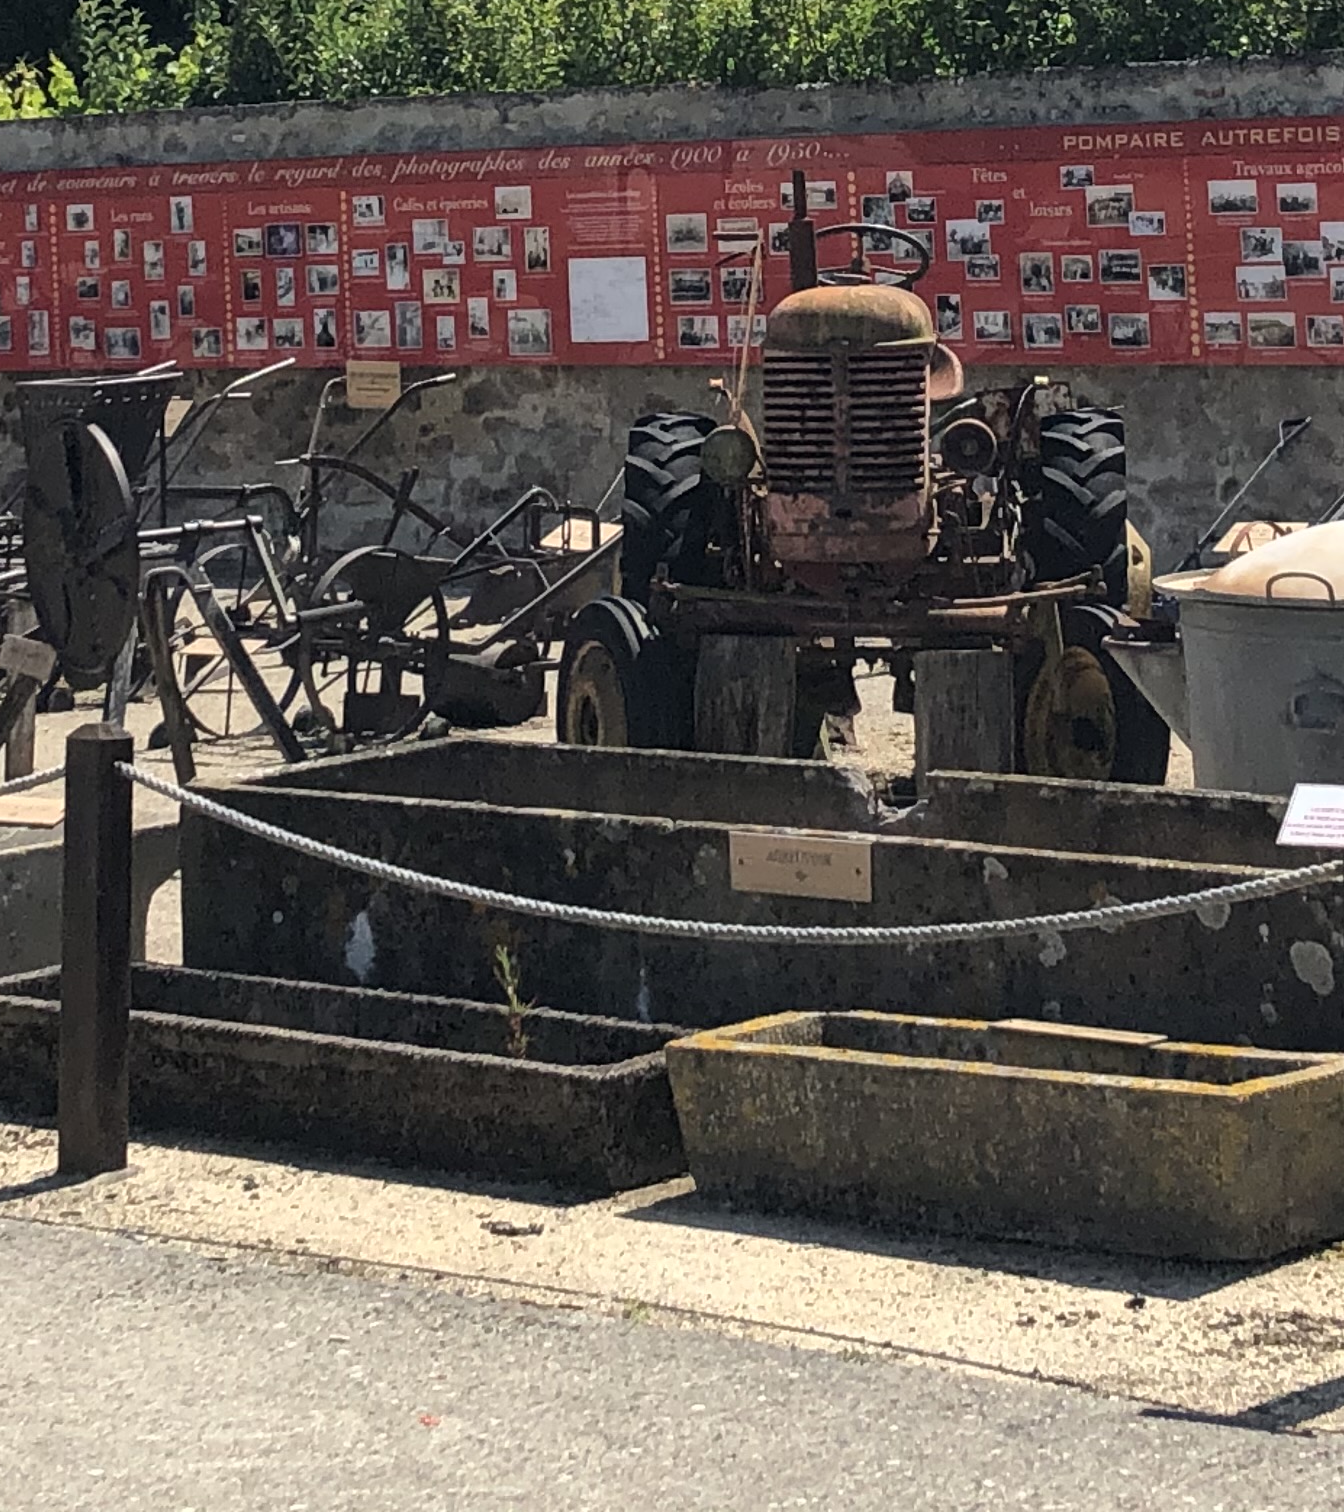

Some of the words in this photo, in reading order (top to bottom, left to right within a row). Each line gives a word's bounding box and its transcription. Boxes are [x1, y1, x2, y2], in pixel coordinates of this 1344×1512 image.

[1063, 131, 1184, 150] POMPAIRE
[1201, 126, 1342, 146] AUTREFOIS
[27, 173, 47, 192] de
[56, 174, 136, 191] souvenirs
[148, 172, 161, 187] à
[172, 170, 239, 185] travers
[248, 162, 265, 182] le
[274, 157, 341, 187] regard
[352, 157, 382, 178] des
[390, 150, 525, 184] photographes
[537, 149, 571, 170] des
[585, 149, 655, 168] années
[670, 145, 723, 170] 1900
[971, 167, 1008, 183] Fêtes
[1232, 159, 1292, 176] Travaux
[1012, 188, 1026, 199] et
[247, 201, 267, 216] Les
[269, 201, 312, 216] artisans
[427, 199, 438, 211] et
[439, 196, 489, 214] épiceries
[713, 198, 726, 211] et
[728, 195, 776, 211] écoliers
[1029, 201, 1073, 218] loisirs
[110, 208, 129, 223] Les
